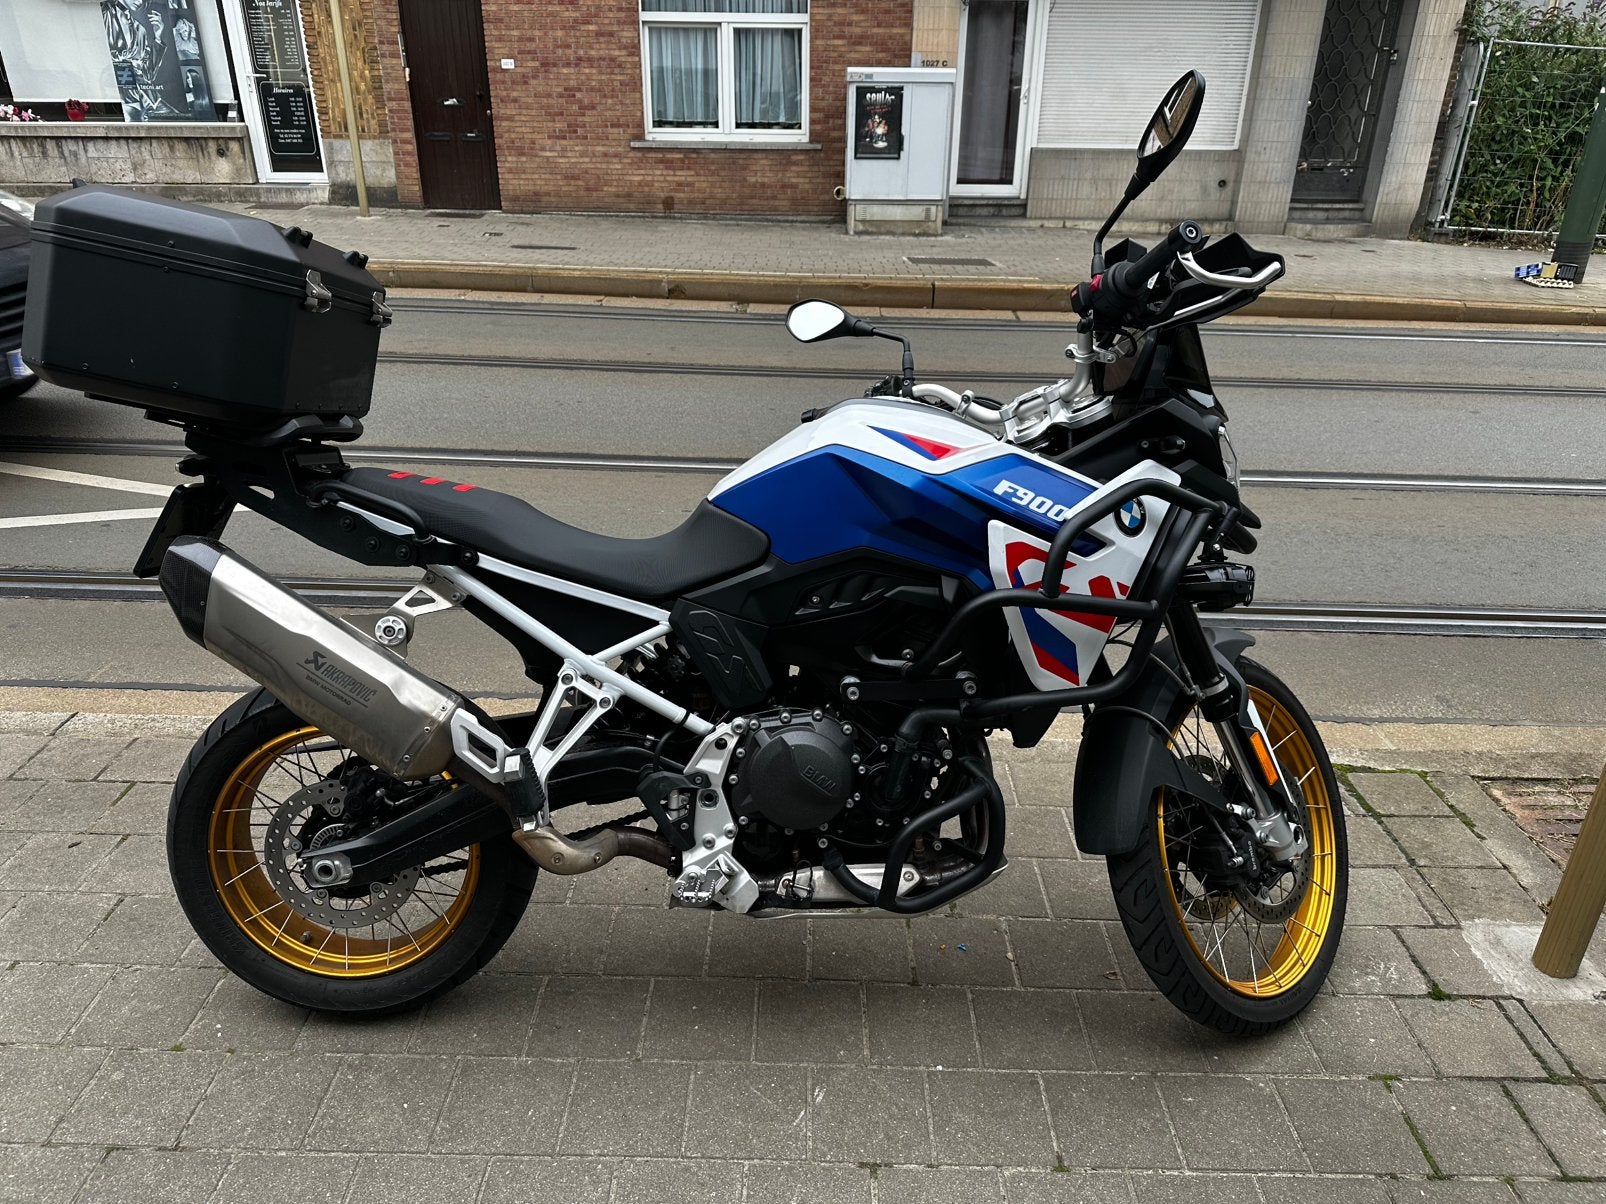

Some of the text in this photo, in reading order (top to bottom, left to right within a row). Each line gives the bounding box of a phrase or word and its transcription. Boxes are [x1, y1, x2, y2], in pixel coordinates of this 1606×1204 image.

[993, 479, 1066, 522] F900
[305, 674, 352, 706] BMW MOTORRAD
[803, 765, 836, 792] BMW
